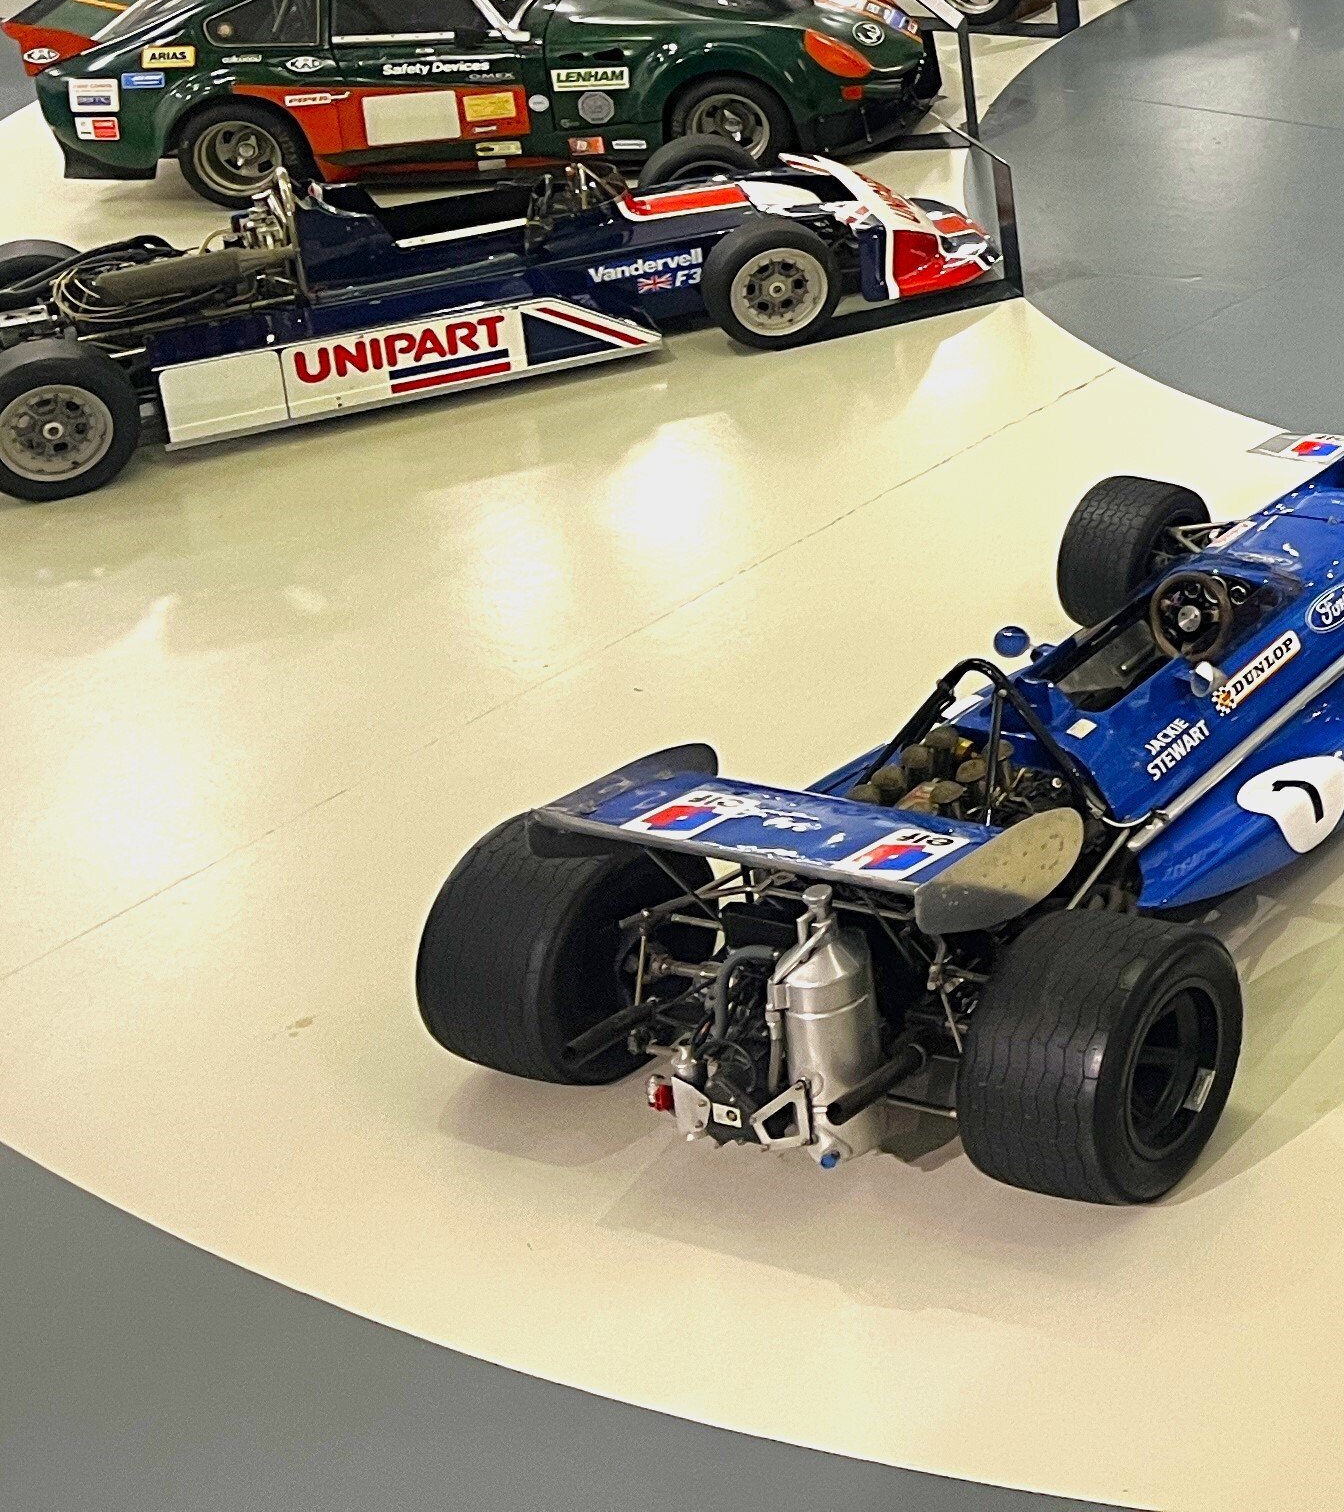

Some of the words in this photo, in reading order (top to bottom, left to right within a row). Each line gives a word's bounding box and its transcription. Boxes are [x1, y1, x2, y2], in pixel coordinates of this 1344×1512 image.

[149, 51, 187, 62] ARIAS
[383, 62, 430, 76] Safety
[432, 60, 490, 73] Devices
[556, 70, 625, 84] LENHAM
[587, 247, 703, 284] Vandervell
[674, 267, 702, 287] F3
[293, 315, 505, 384] UNIPART
[1231, 637, 1293, 696] DUNLOP
[1144, 717, 1190, 756] JACKIE
[1146, 719, 1211, 781] STEWART
[1271, 779, 1325, 824] 1
[898, 830, 955, 847] elf
